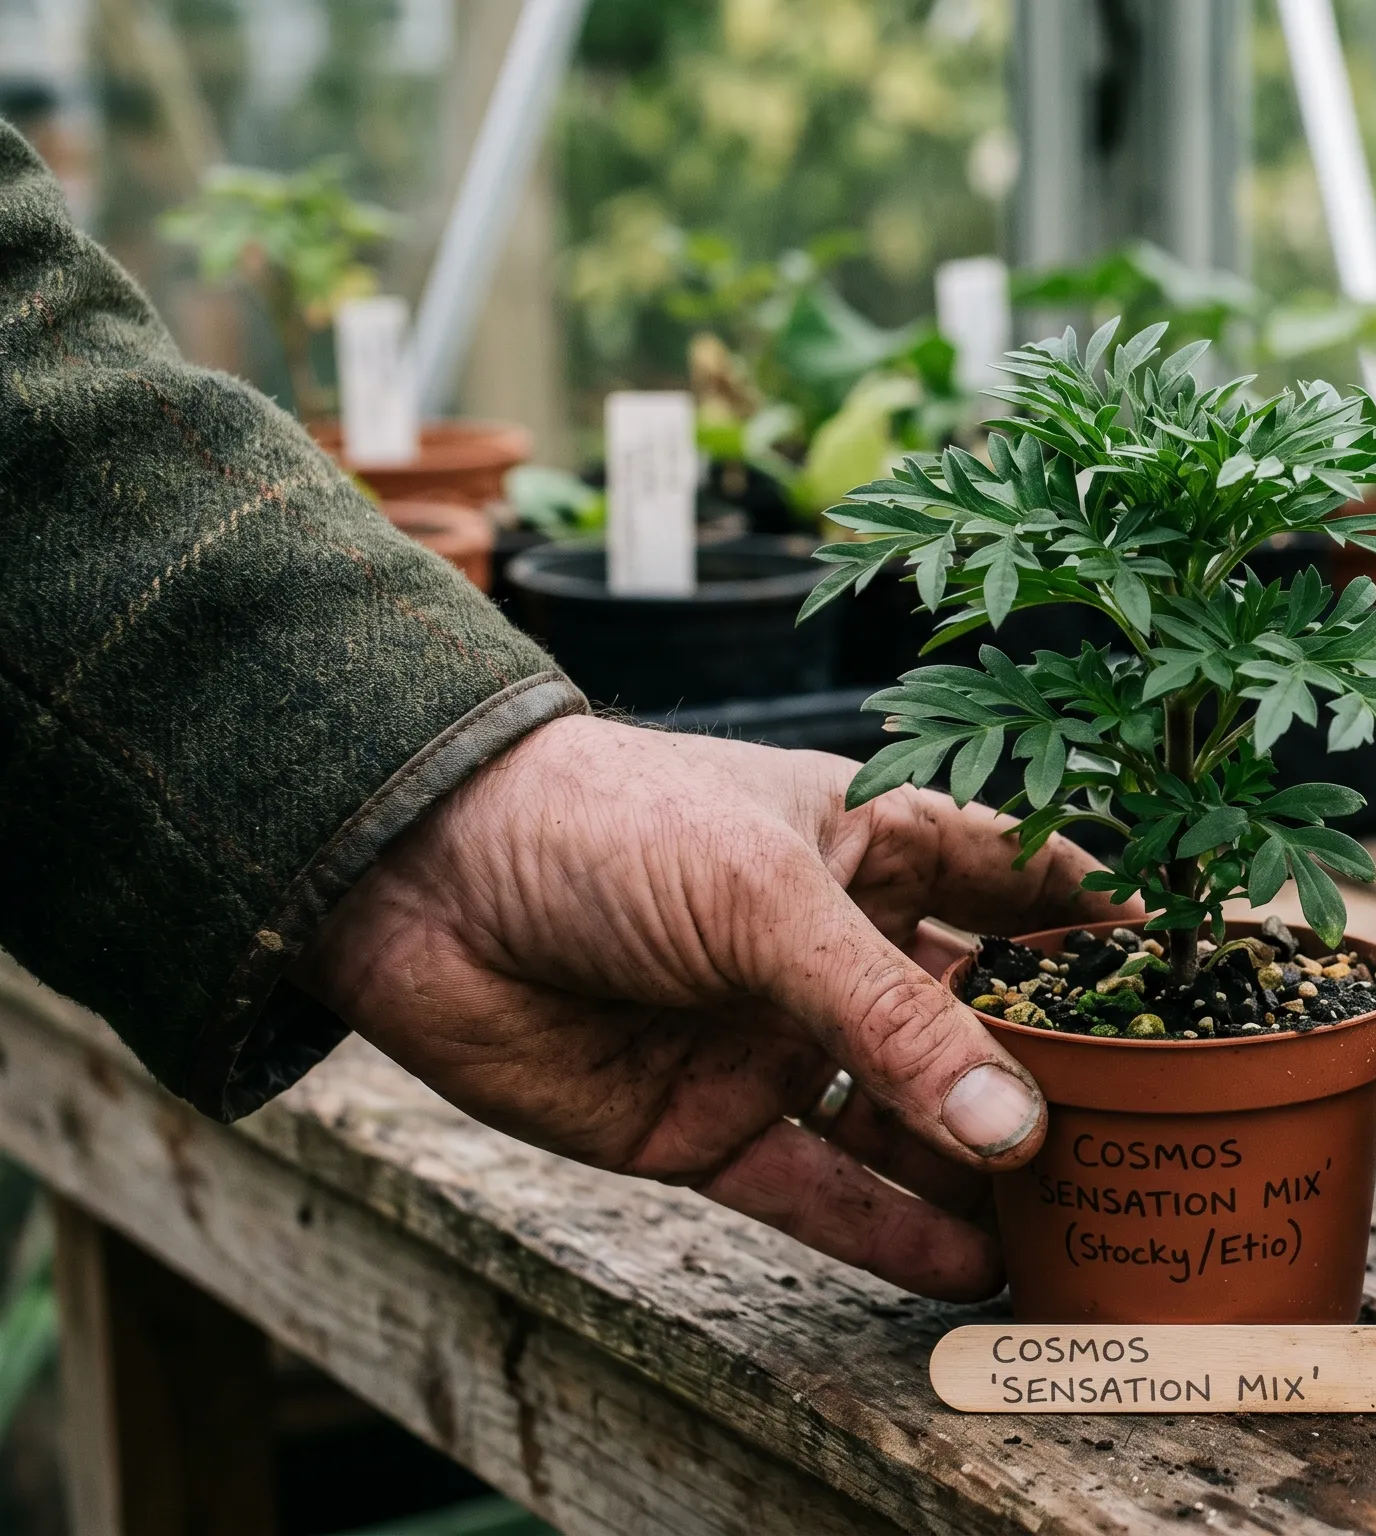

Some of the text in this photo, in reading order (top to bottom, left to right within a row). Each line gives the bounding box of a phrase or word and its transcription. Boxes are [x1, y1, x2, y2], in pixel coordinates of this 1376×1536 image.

[1073, 1134, 1243, 1170] COSMOS
[1263, 1157, 1332, 1209] MIX'
[1065, 1218, 1302, 1283] (Stocky/Etio)
[992, 1335, 1149, 1363] COSMOS
[991, 1366, 1320, 1404] 'SENSATION MIX'
